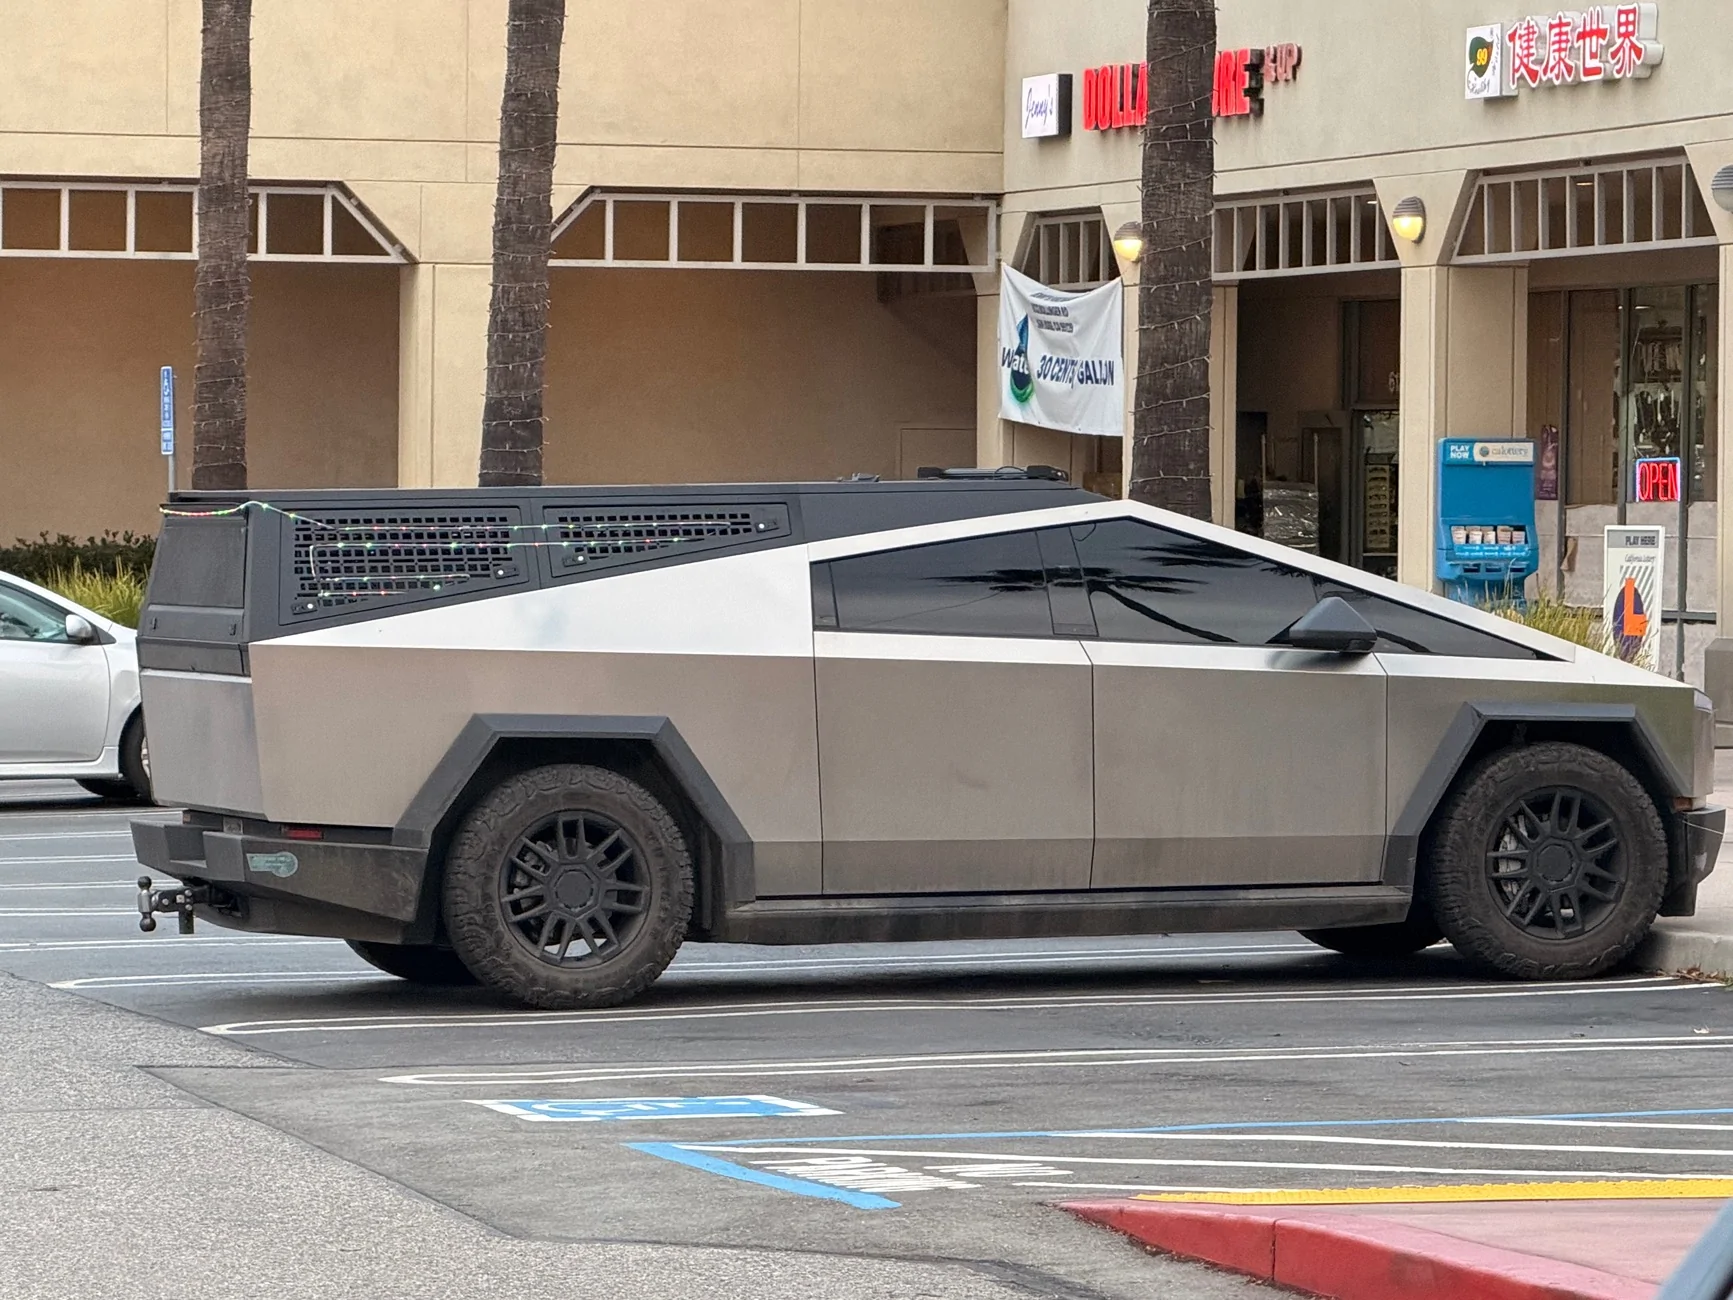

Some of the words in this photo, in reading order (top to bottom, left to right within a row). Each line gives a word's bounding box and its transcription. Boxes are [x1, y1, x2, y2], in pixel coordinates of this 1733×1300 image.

[1476, 48, 1488, 66] 99
[1507, 5, 1644, 88] 健康世界
[1025, 84, 1054, 129] Jenny's
[1083, 62, 1148, 131] DOLLA
[1037, 354, 1054, 380] 30
[1450, 451, 1470, 459] NOW
[1638, 462, 1679, 501] OPEN
[1625, 535, 1640, 546] PLAY
